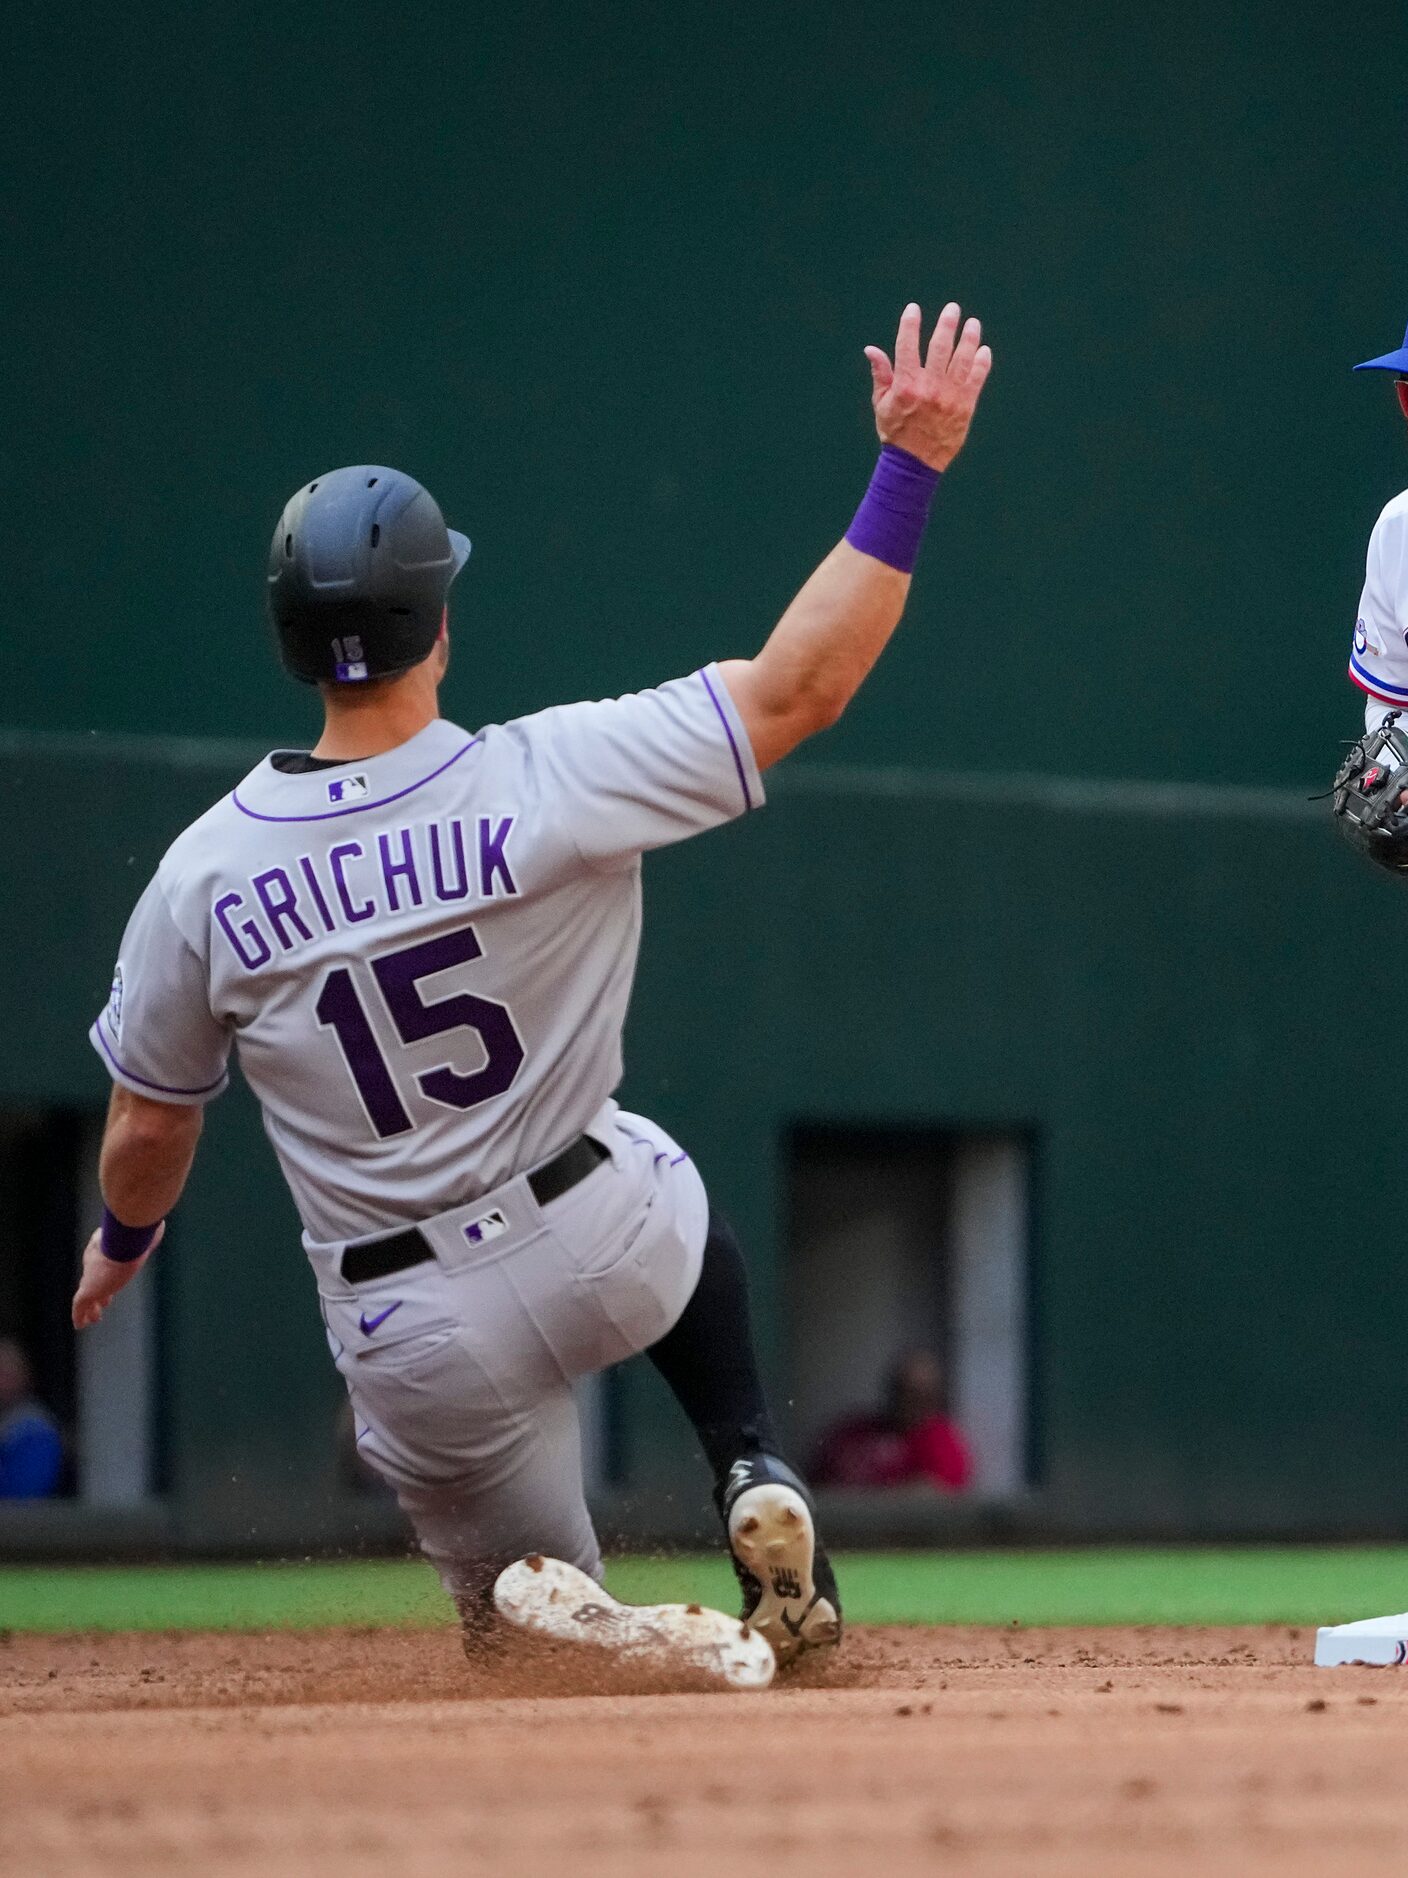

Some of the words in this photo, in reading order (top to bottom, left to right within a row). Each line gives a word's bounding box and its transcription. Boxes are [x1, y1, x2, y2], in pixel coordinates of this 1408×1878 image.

[331, 635, 364, 663] 15
[213, 815, 520, 972] GRICHUK
[315, 922, 528, 1141] 15
